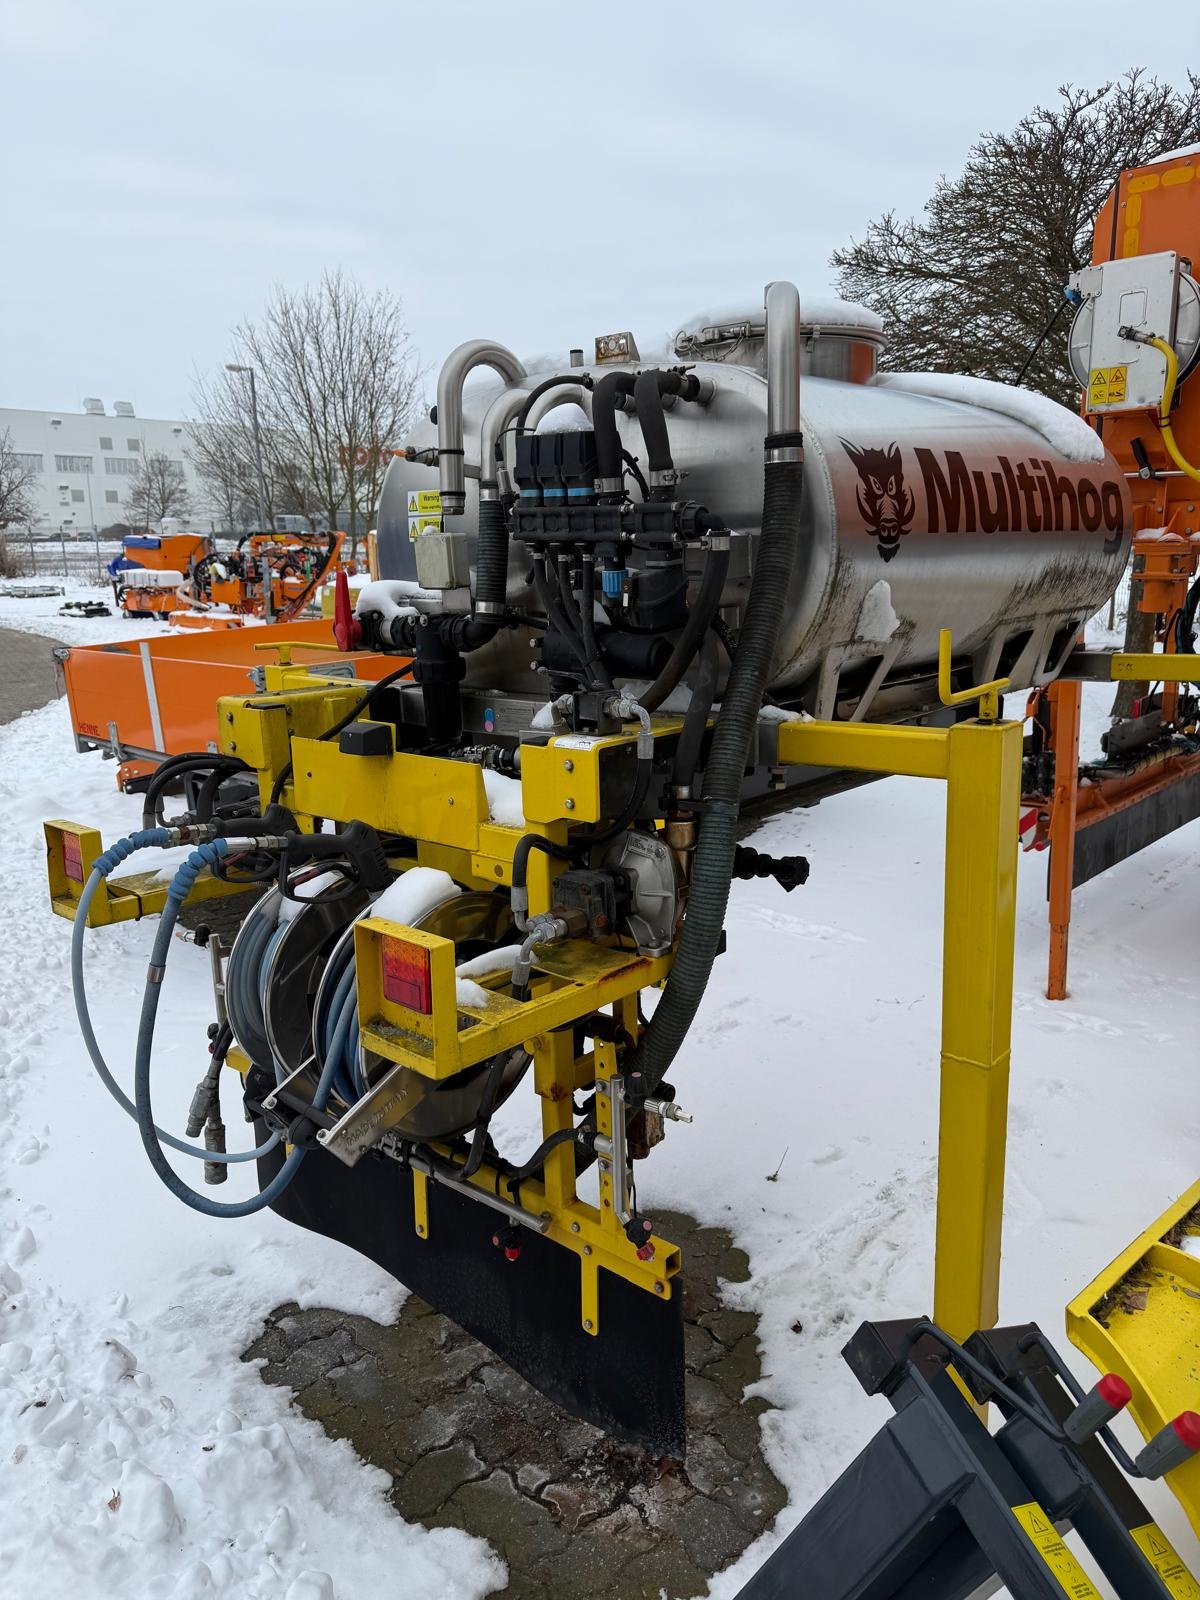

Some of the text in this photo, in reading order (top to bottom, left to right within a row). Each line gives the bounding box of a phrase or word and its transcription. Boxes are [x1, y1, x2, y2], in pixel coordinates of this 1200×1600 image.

[423, 494, 440, 502] Warning
[913, 447, 1124, 554] Multihog
[78, 722, 100, 736] HENNE
